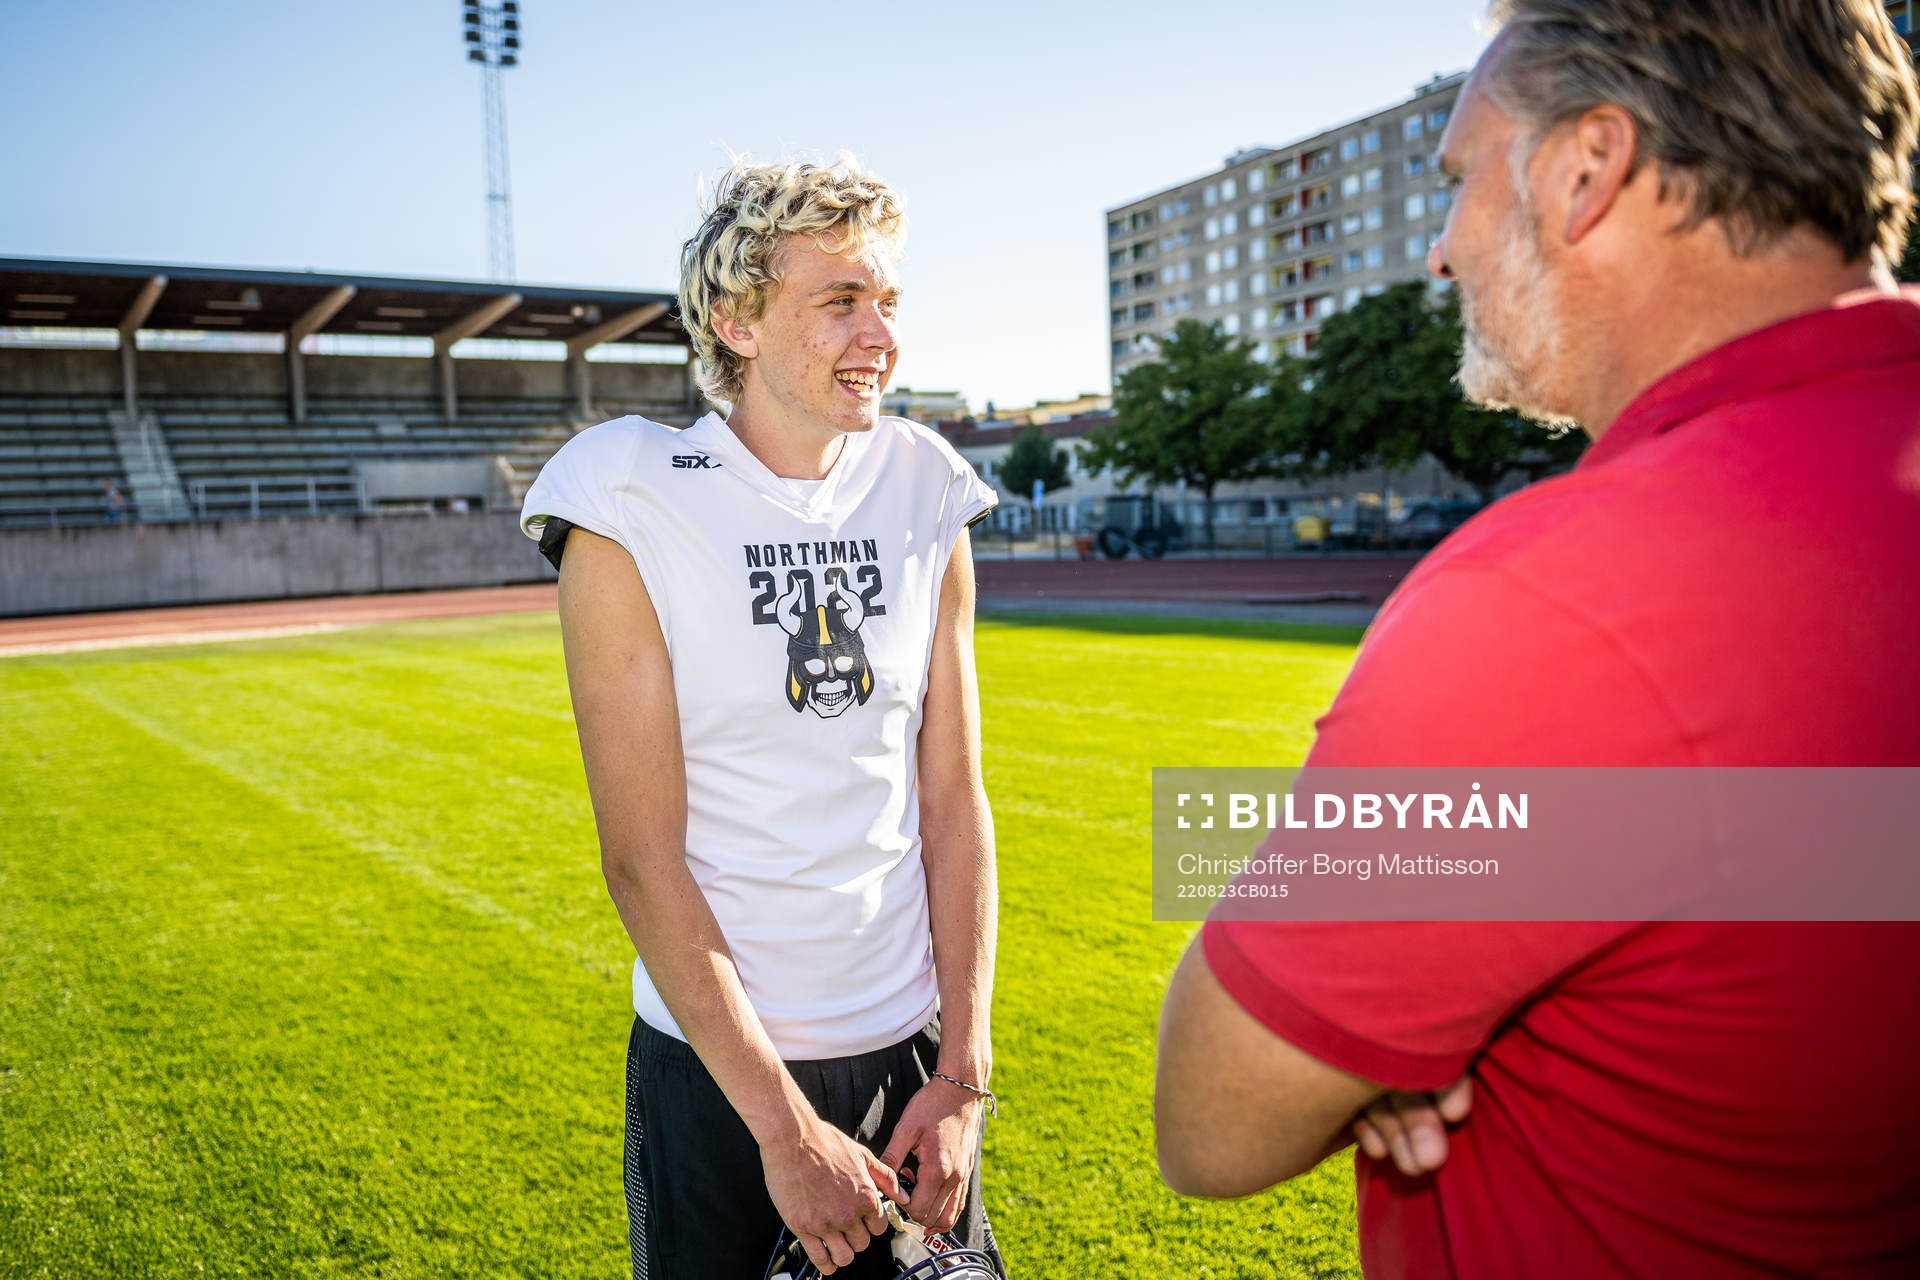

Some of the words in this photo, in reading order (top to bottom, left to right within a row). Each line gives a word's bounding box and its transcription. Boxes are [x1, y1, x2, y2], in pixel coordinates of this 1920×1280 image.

[672, 455, 711, 469] STX
[743, 538, 879, 568] NORTHMAN
[749, 564, 887, 625] 2022
